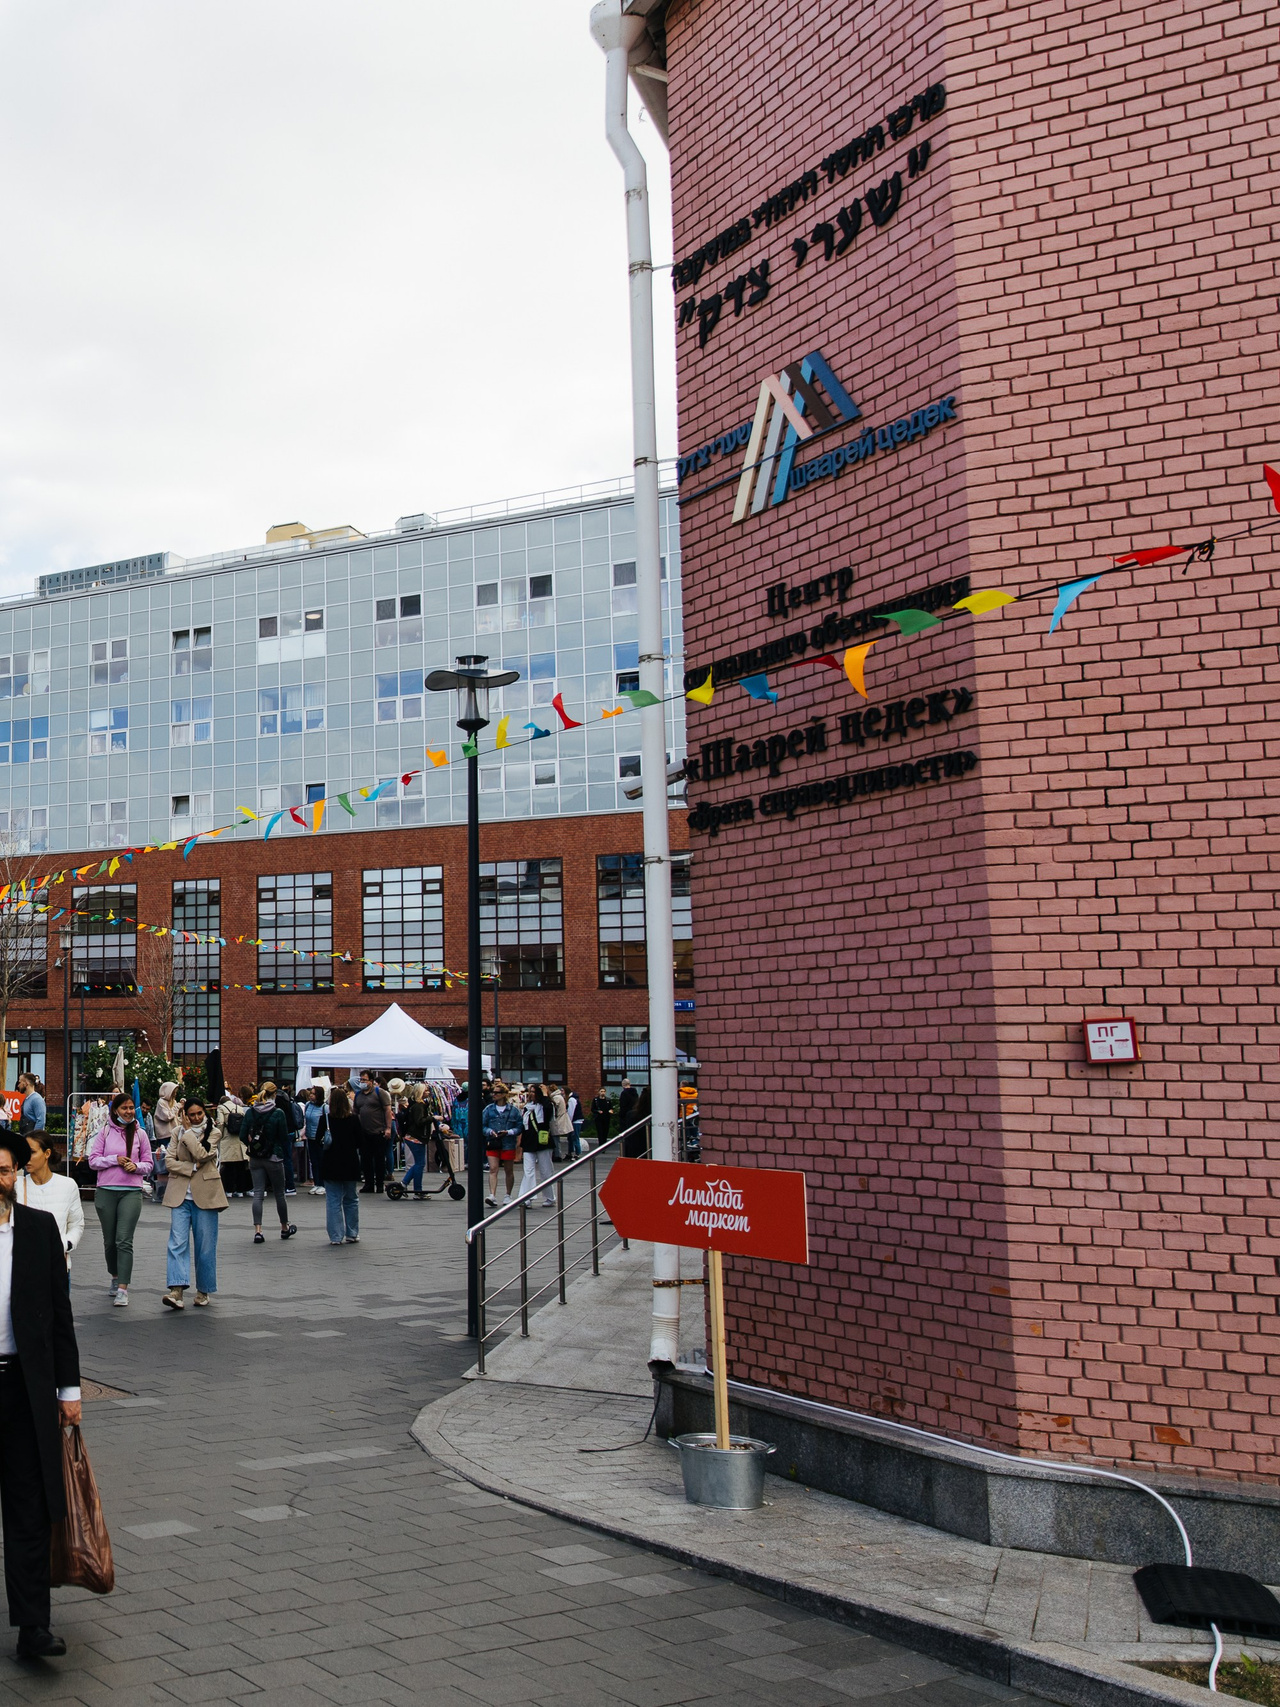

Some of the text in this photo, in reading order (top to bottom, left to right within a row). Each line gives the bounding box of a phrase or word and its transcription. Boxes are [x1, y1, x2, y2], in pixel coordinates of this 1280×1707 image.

[886, 82, 946, 142] מרכז
[820, 124, 885, 184] החסד
[787, 395, 957, 492] шаарей цедек
[765, 566, 854, 619] Центр
[1097, 1025, 1119, 1037] ПГ
[668, 1177, 744, 1210] Ламбада
[684, 1209, 750, 1237] маркет
